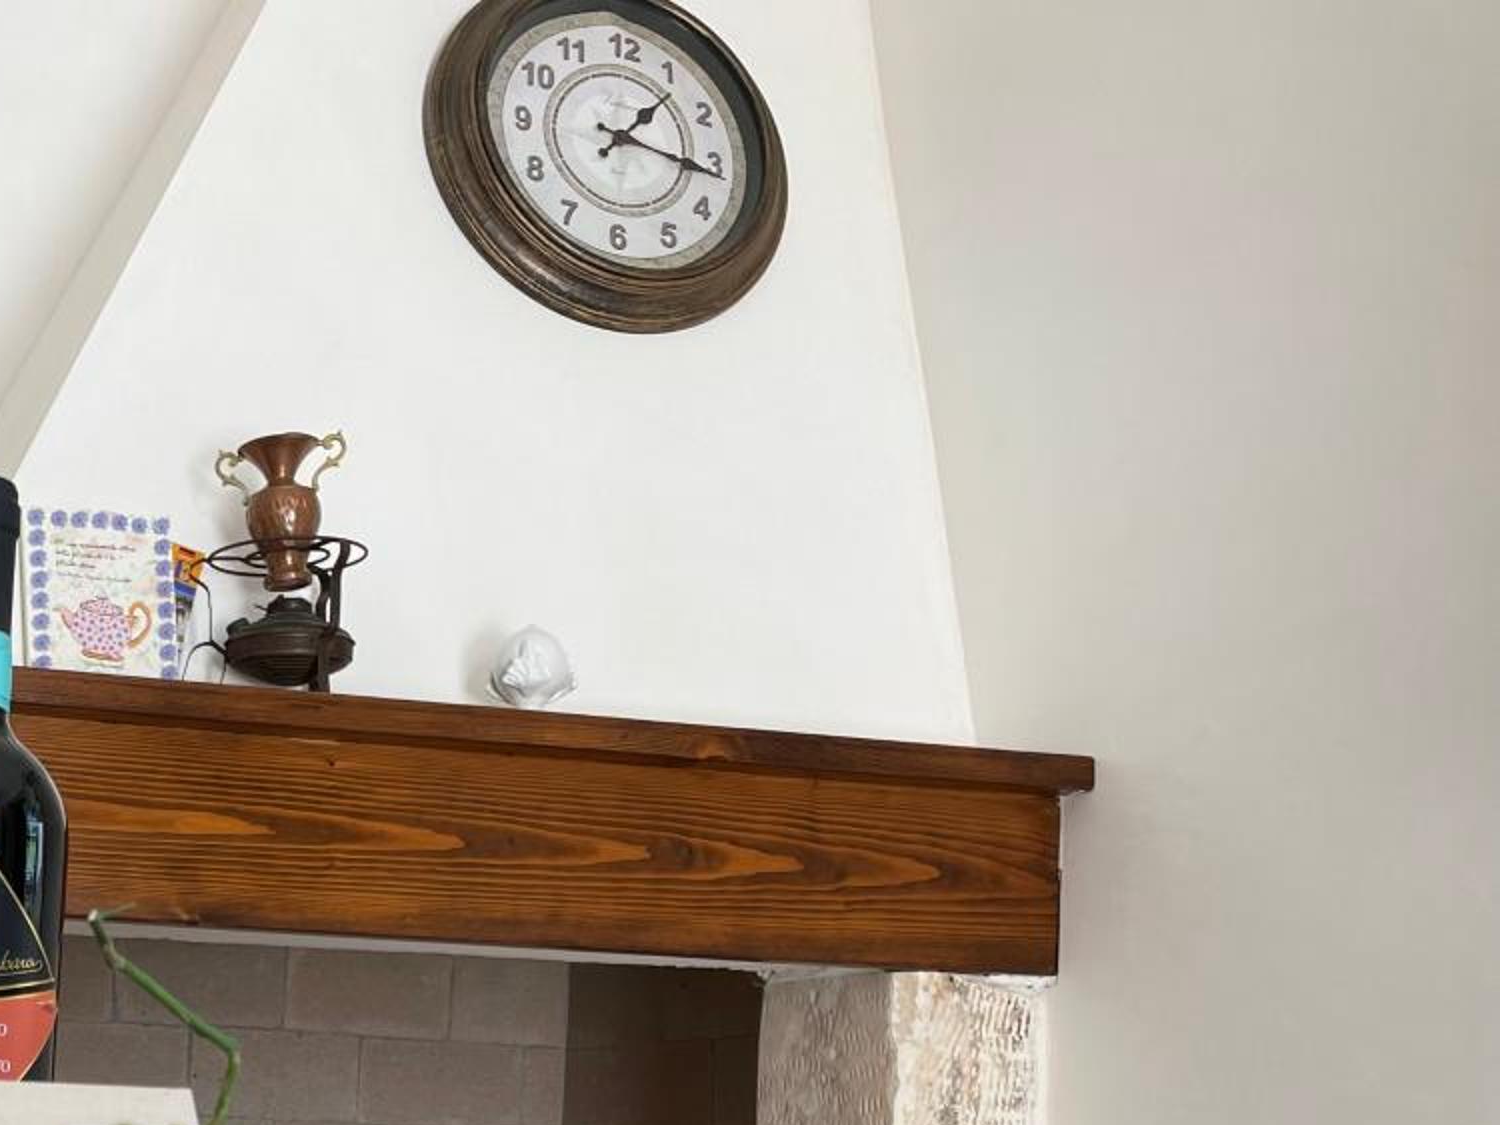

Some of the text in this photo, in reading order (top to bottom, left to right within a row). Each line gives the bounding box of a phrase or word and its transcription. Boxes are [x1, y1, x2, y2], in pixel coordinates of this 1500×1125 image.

[557, 37, 585, 63] 11
[608, 33, 641, 63] 12
[521, 61, 555, 89] 10
[661, 60, 674, 84] 1
[515, 105, 532, 131] 9
[695, 101, 713, 129] 2
[526, 155, 545, 182] 8
[707, 151, 724, 178] 3
[561, 199, 579, 226] 7
[693, 195, 712, 221] 4
[609, 223, 627, 250] 6
[660, 221, 678, 248] 5
